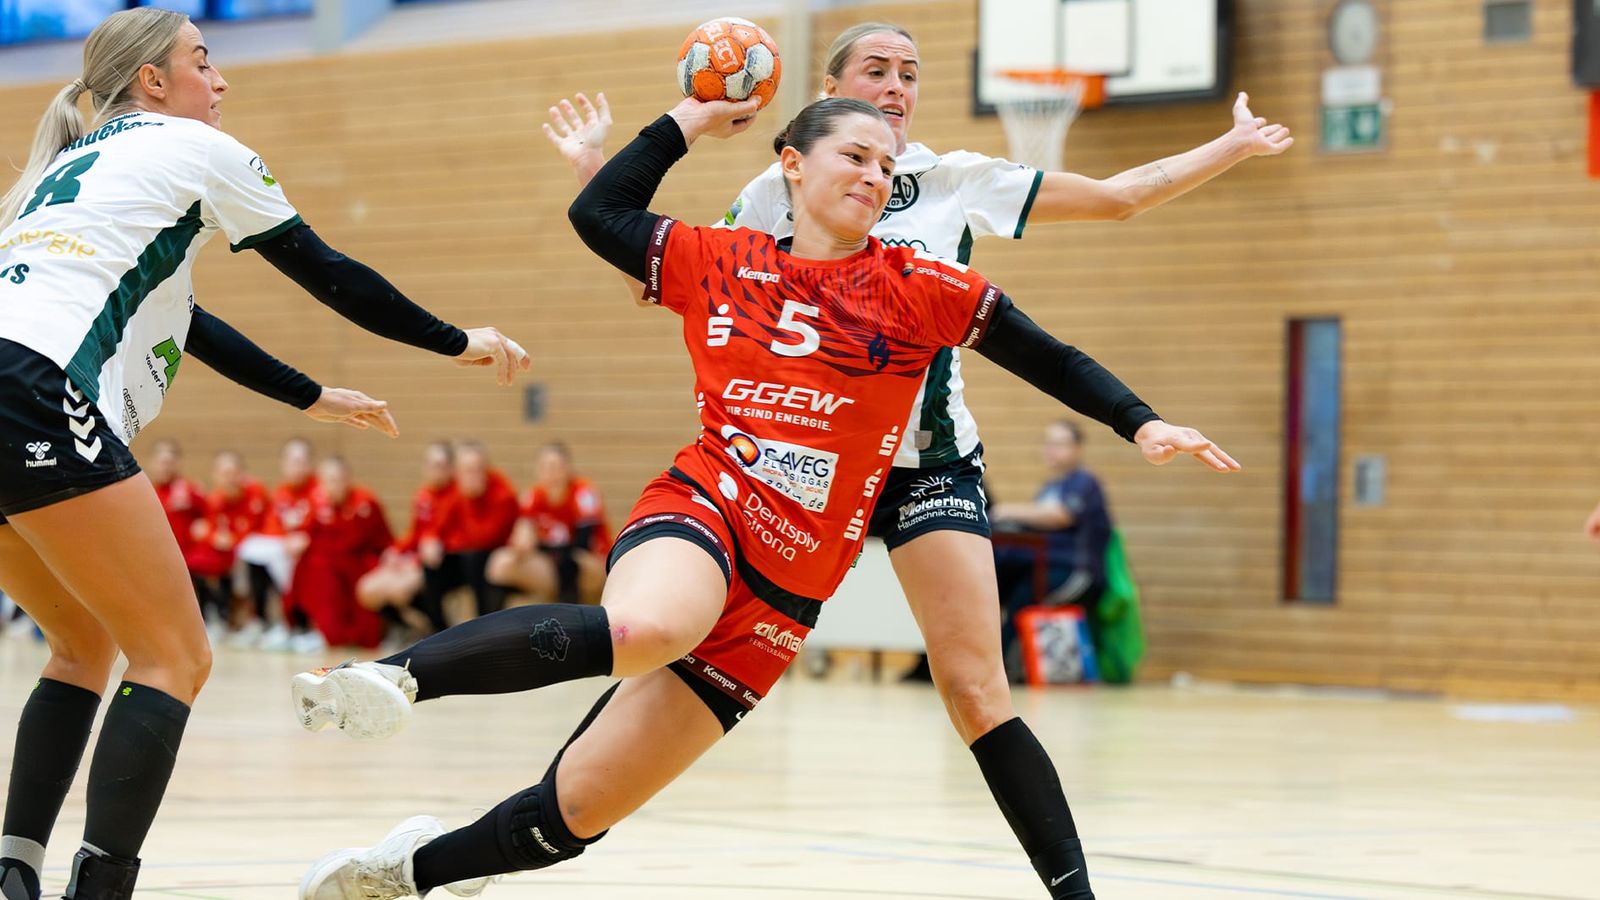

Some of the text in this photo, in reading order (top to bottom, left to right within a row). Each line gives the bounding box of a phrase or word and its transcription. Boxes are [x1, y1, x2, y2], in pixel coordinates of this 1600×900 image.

[651, 256, 661, 291] Kempa
[737, 266, 780, 283] Kempa
[975, 288, 997, 321] Kempa
[769, 299, 821, 357] 5
[123, 387, 138, 420] GEORG
[722, 378, 856, 416] GGEW
[742, 407, 773, 421] SIND
[774, 411, 833, 432] ENERGIE.
[25, 459, 57, 469] hummel
[897, 508, 979, 531] Haustechnik GmbH
[898, 495, 978, 521] Molderings
[684, 517, 719, 544] Kempa
[744, 492, 822, 553] Dentsply
[703, 664, 738, 691] Kempa
